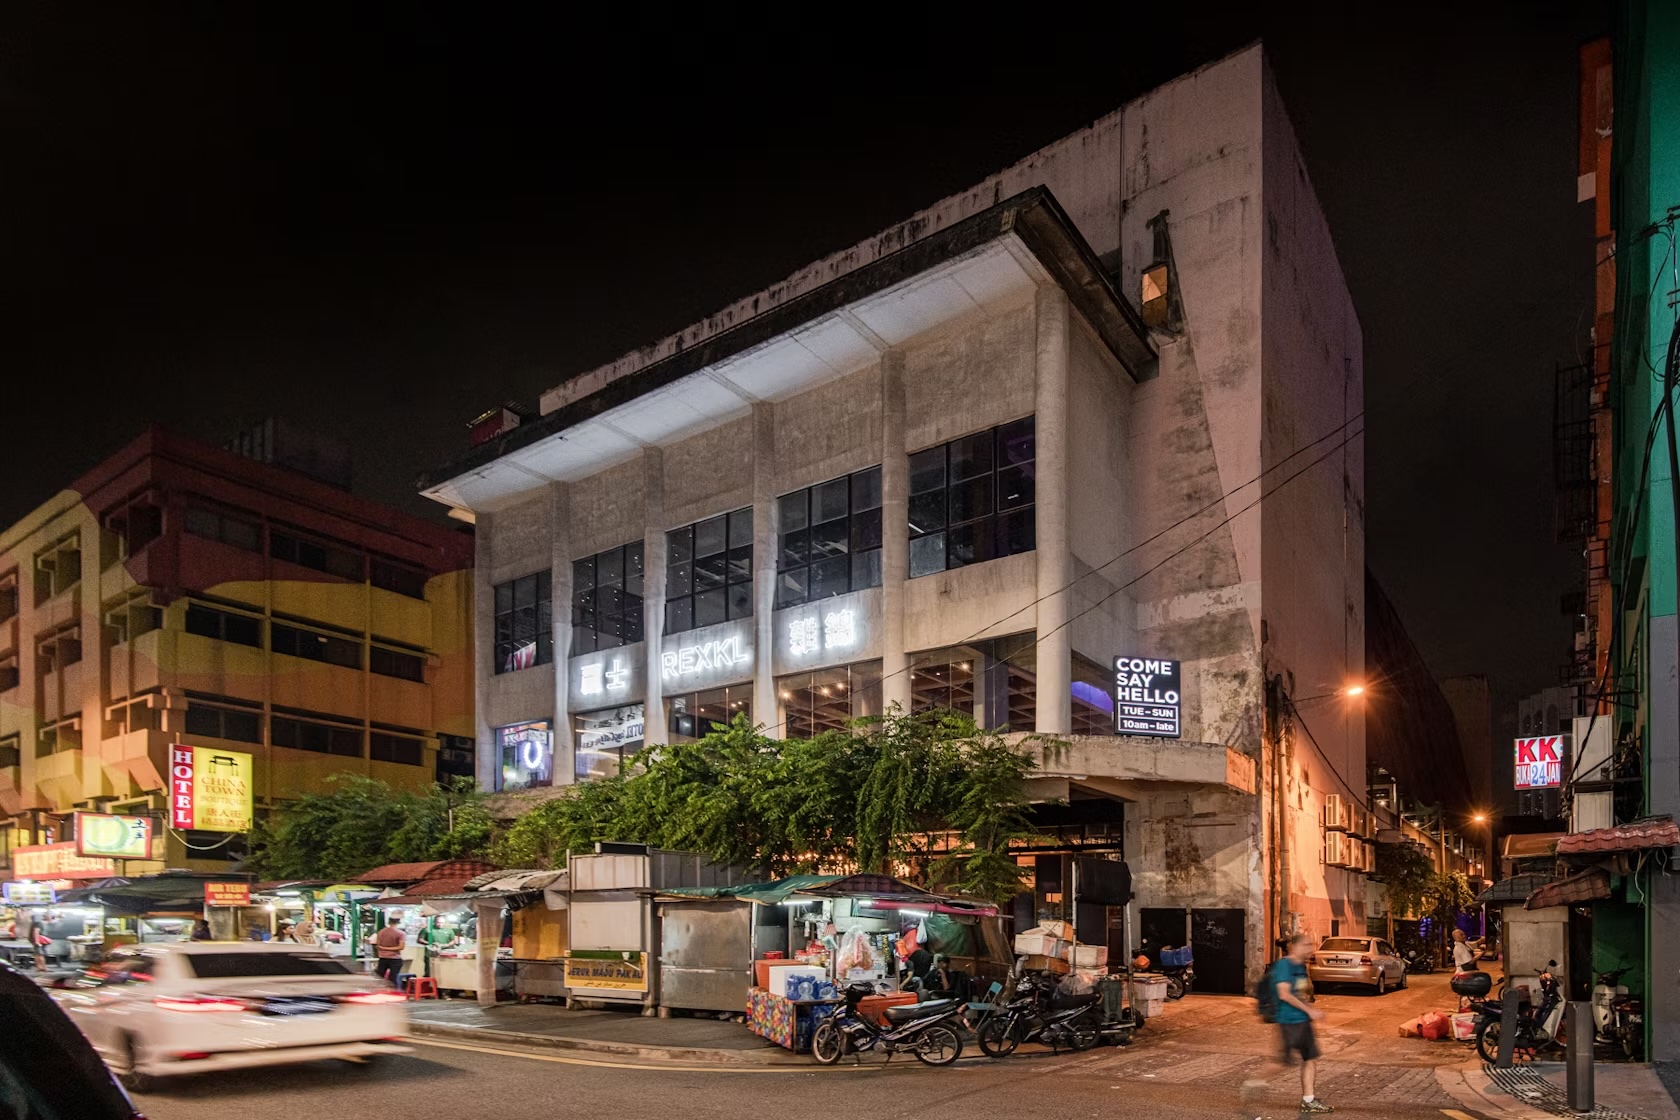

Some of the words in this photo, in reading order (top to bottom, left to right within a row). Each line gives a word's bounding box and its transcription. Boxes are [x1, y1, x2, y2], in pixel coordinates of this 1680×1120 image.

[661, 636, 749, 680] REXKL
[1116, 658, 1172, 675] COME
[1117, 672, 1153, 688] SAY
[1117, 686, 1179, 704] HELLO
[1518, 737, 1559, 763] KK
[201, 776, 247, 789] CHINA
[1531, 763, 1546, 785] 24
[173, 749, 193, 824] HOTEL
[204, 785, 246, 797] TOWN
